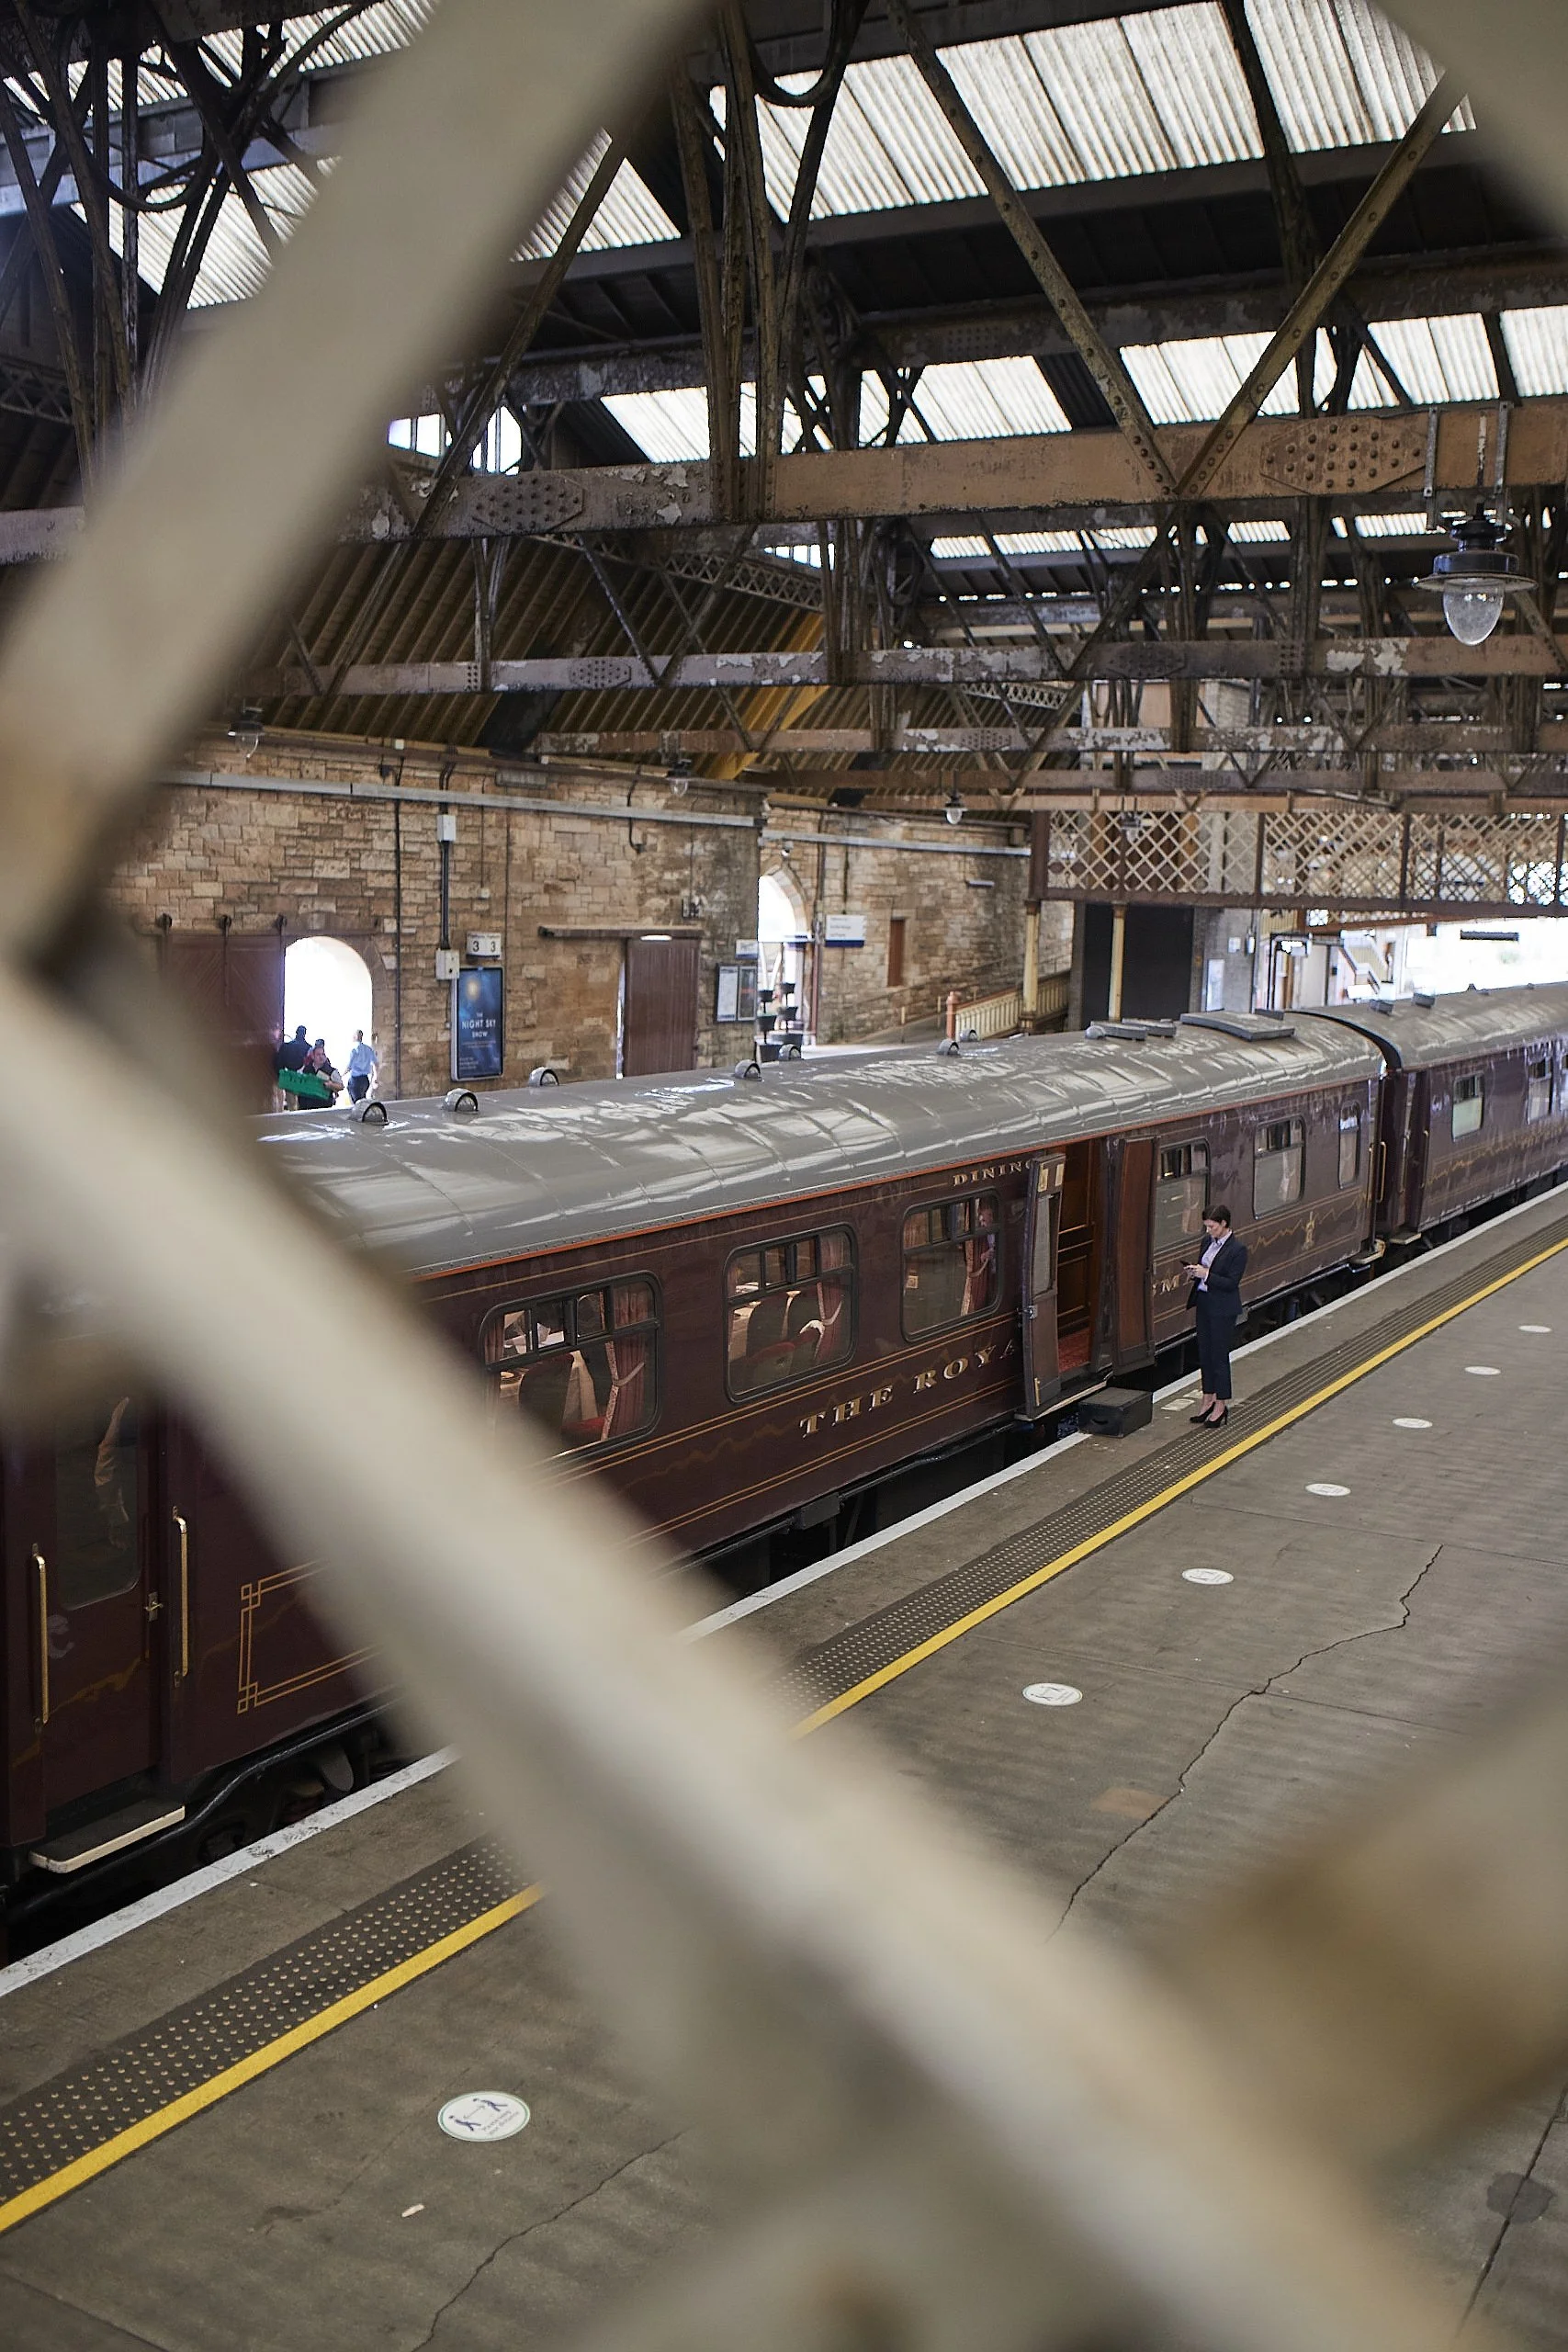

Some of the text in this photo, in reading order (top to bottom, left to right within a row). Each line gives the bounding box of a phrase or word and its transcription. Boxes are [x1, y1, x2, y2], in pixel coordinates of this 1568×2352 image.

[472, 940, 479, 953] 3
[491, 941, 496, 953] 3
[461, 1018, 496, 1030] NIGHT SKY
[799, 1385, 894, 1439] THE
